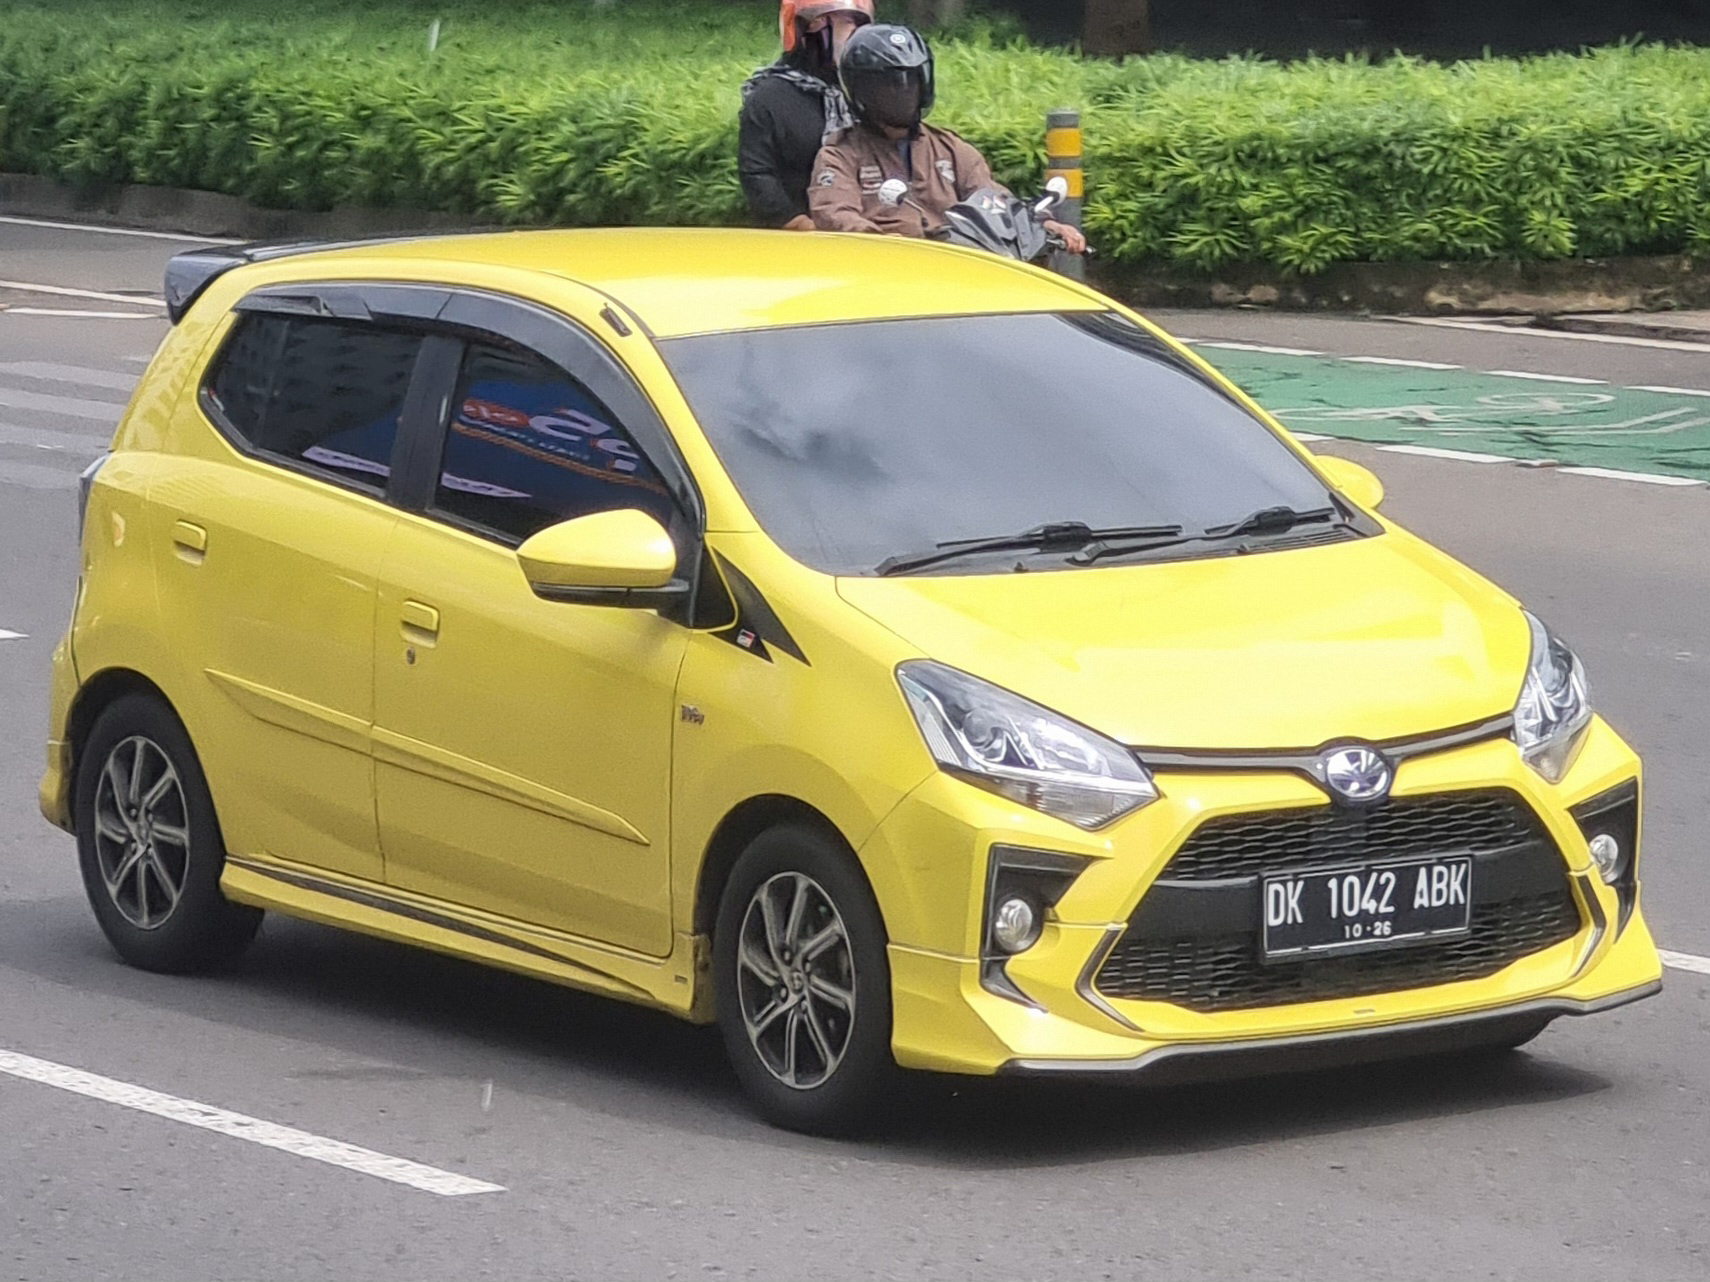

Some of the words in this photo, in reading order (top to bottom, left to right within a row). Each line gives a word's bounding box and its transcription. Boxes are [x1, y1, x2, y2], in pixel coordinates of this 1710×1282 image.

[1267, 880, 1304, 926] DK
[1327, 871, 1396, 919] 1042
[1414, 863, 1467, 909] ABK
